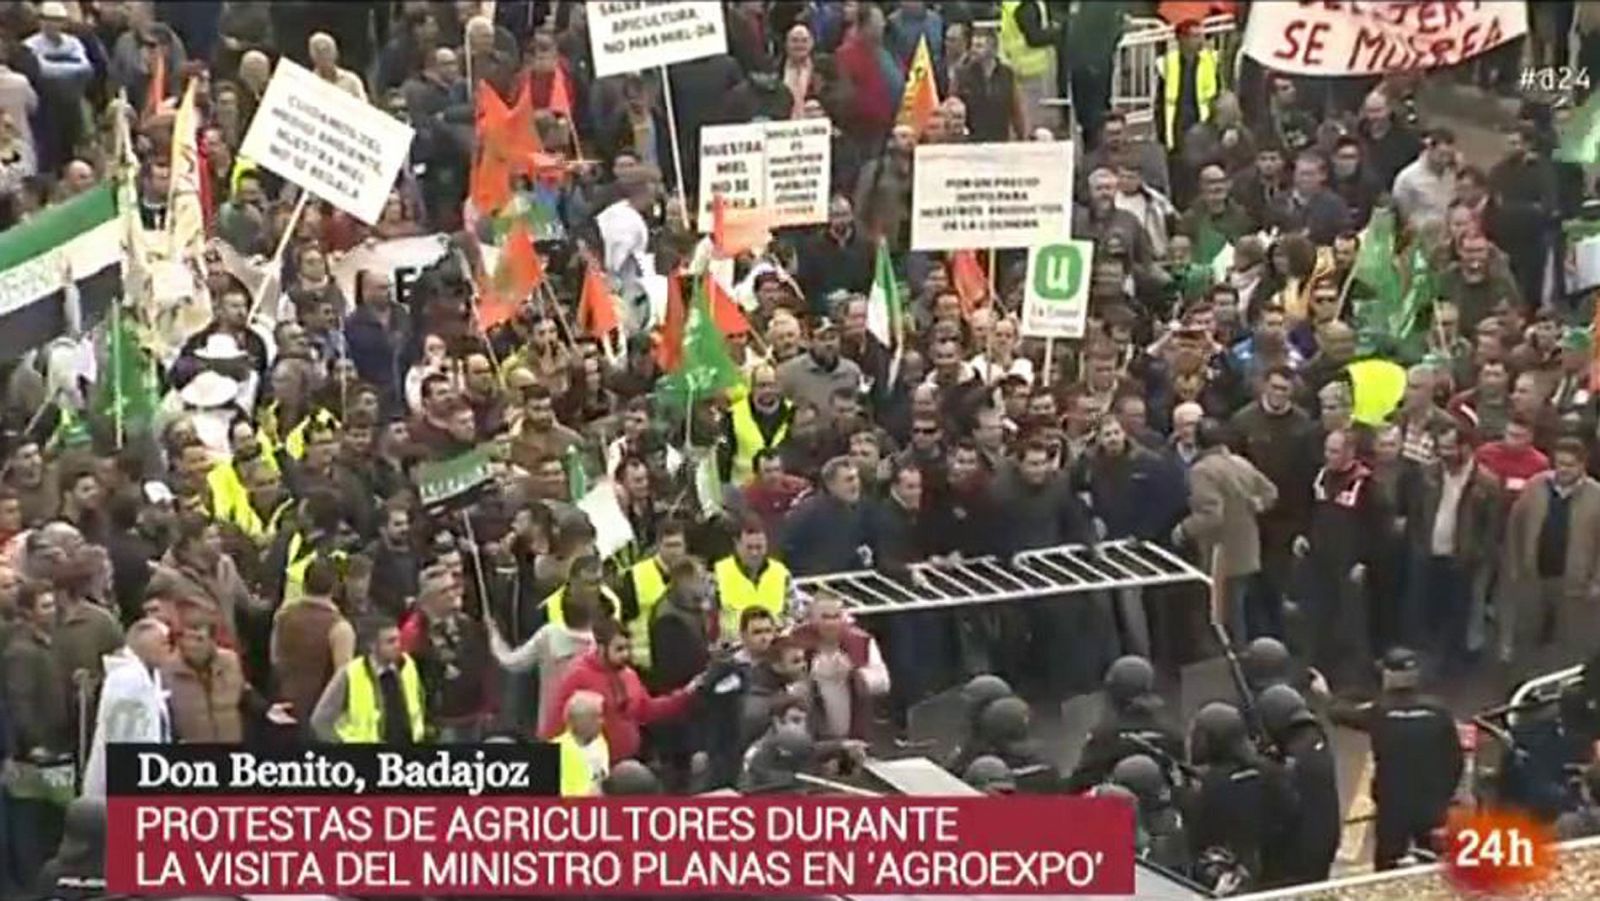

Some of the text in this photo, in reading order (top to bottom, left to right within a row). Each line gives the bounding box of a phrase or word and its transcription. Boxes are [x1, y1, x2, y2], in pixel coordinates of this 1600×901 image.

[603, 40, 626, 54] NO
[629, 33, 659, 50] MAS
[1274, 20, 1331, 65] SE
[269, 144, 291, 161] NO
[703, 140, 762, 156] NUESTRA
[716, 161, 748, 174] MIEL
[711, 179, 749, 193] NO SE
